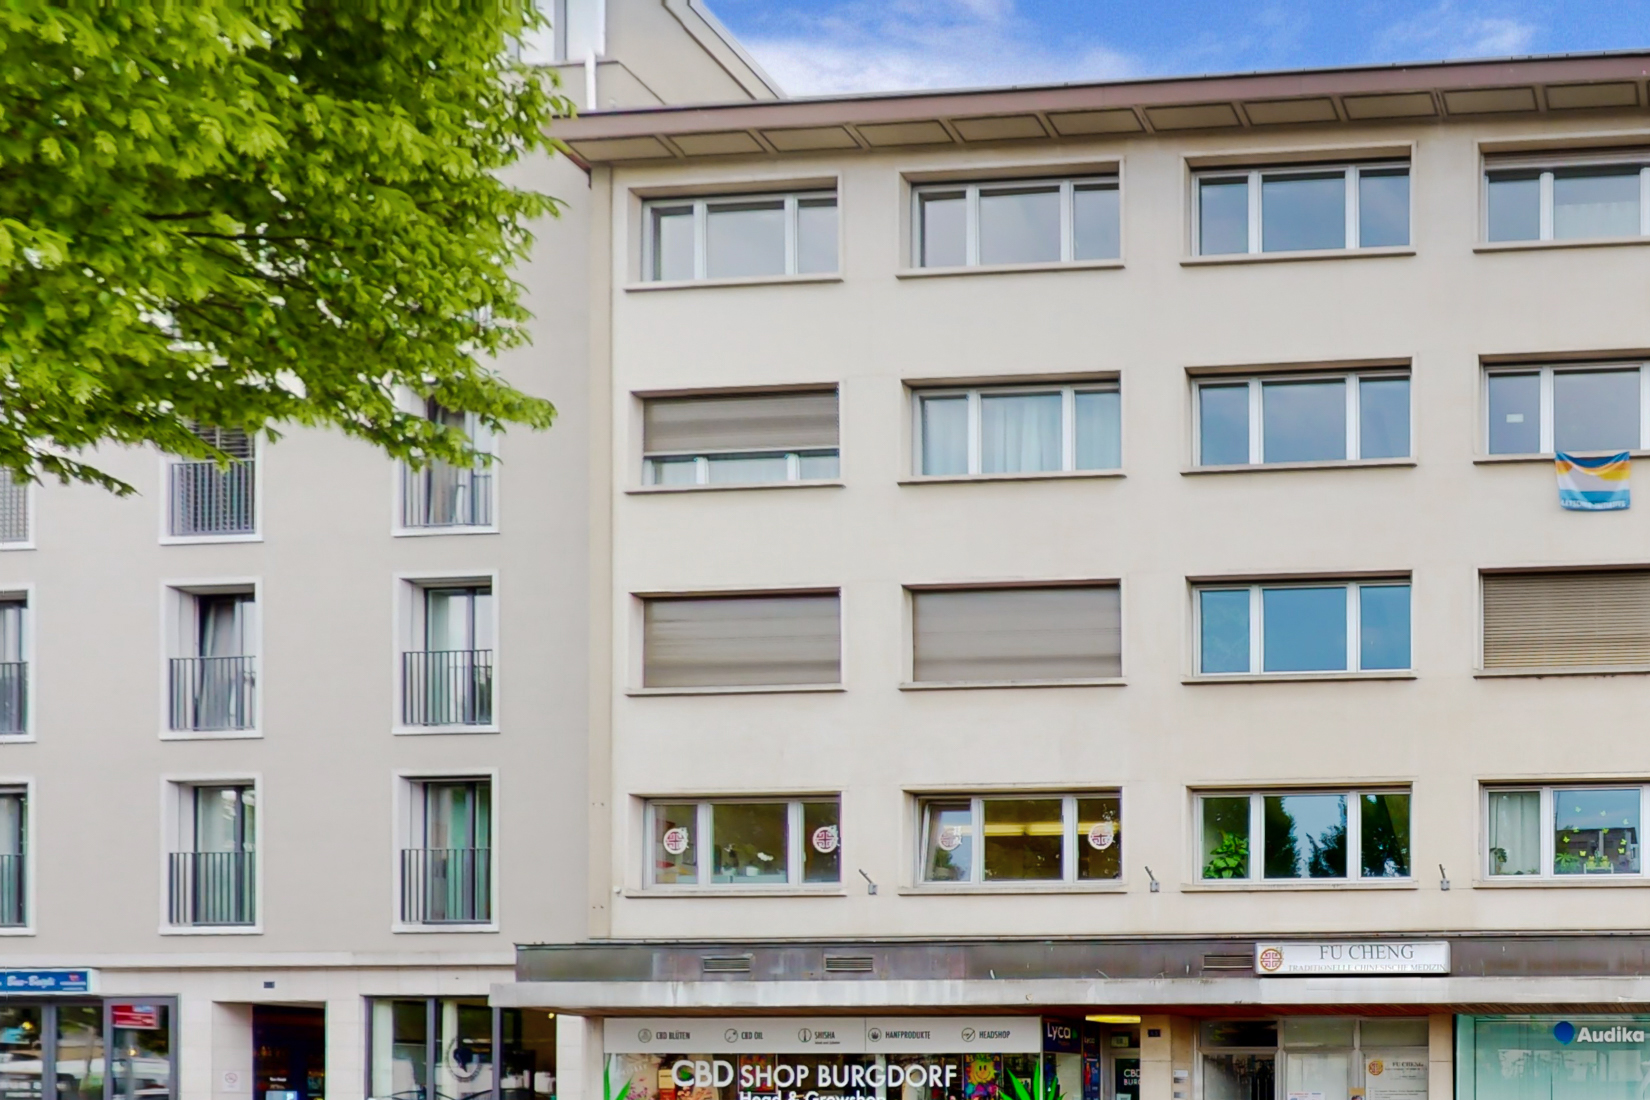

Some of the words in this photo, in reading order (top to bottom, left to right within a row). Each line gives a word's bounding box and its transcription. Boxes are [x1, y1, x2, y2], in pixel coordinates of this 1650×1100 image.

[1320, 945, 1342, 959] FU
[1348, 944, 1414, 960] CHENG
[1289, 964, 1351, 972] TRADITIONELLE
[1354, 964, 1407, 972] CHINESISCHE
[1411, 963, 1447, 972] MEDIZIN
[656, 1031, 668, 1040] CBD
[669, 1029, 690, 1040] BLÜTEN
[741, 1031, 753, 1040] CBD
[814, 1031, 836, 1040] SHISHA
[885, 1030, 931, 1040] HANFPRODUKTE
[979, 1030, 1011, 1039] HEADSHOP
[1047, 1022, 1071, 1041] Lyca
[1577, 1026, 1645, 1043] Audika
[671, 1060, 734, 1088] CBD
[740, 1064, 809, 1088] SHOP
[818, 1064, 958, 1088] BURGDORF
